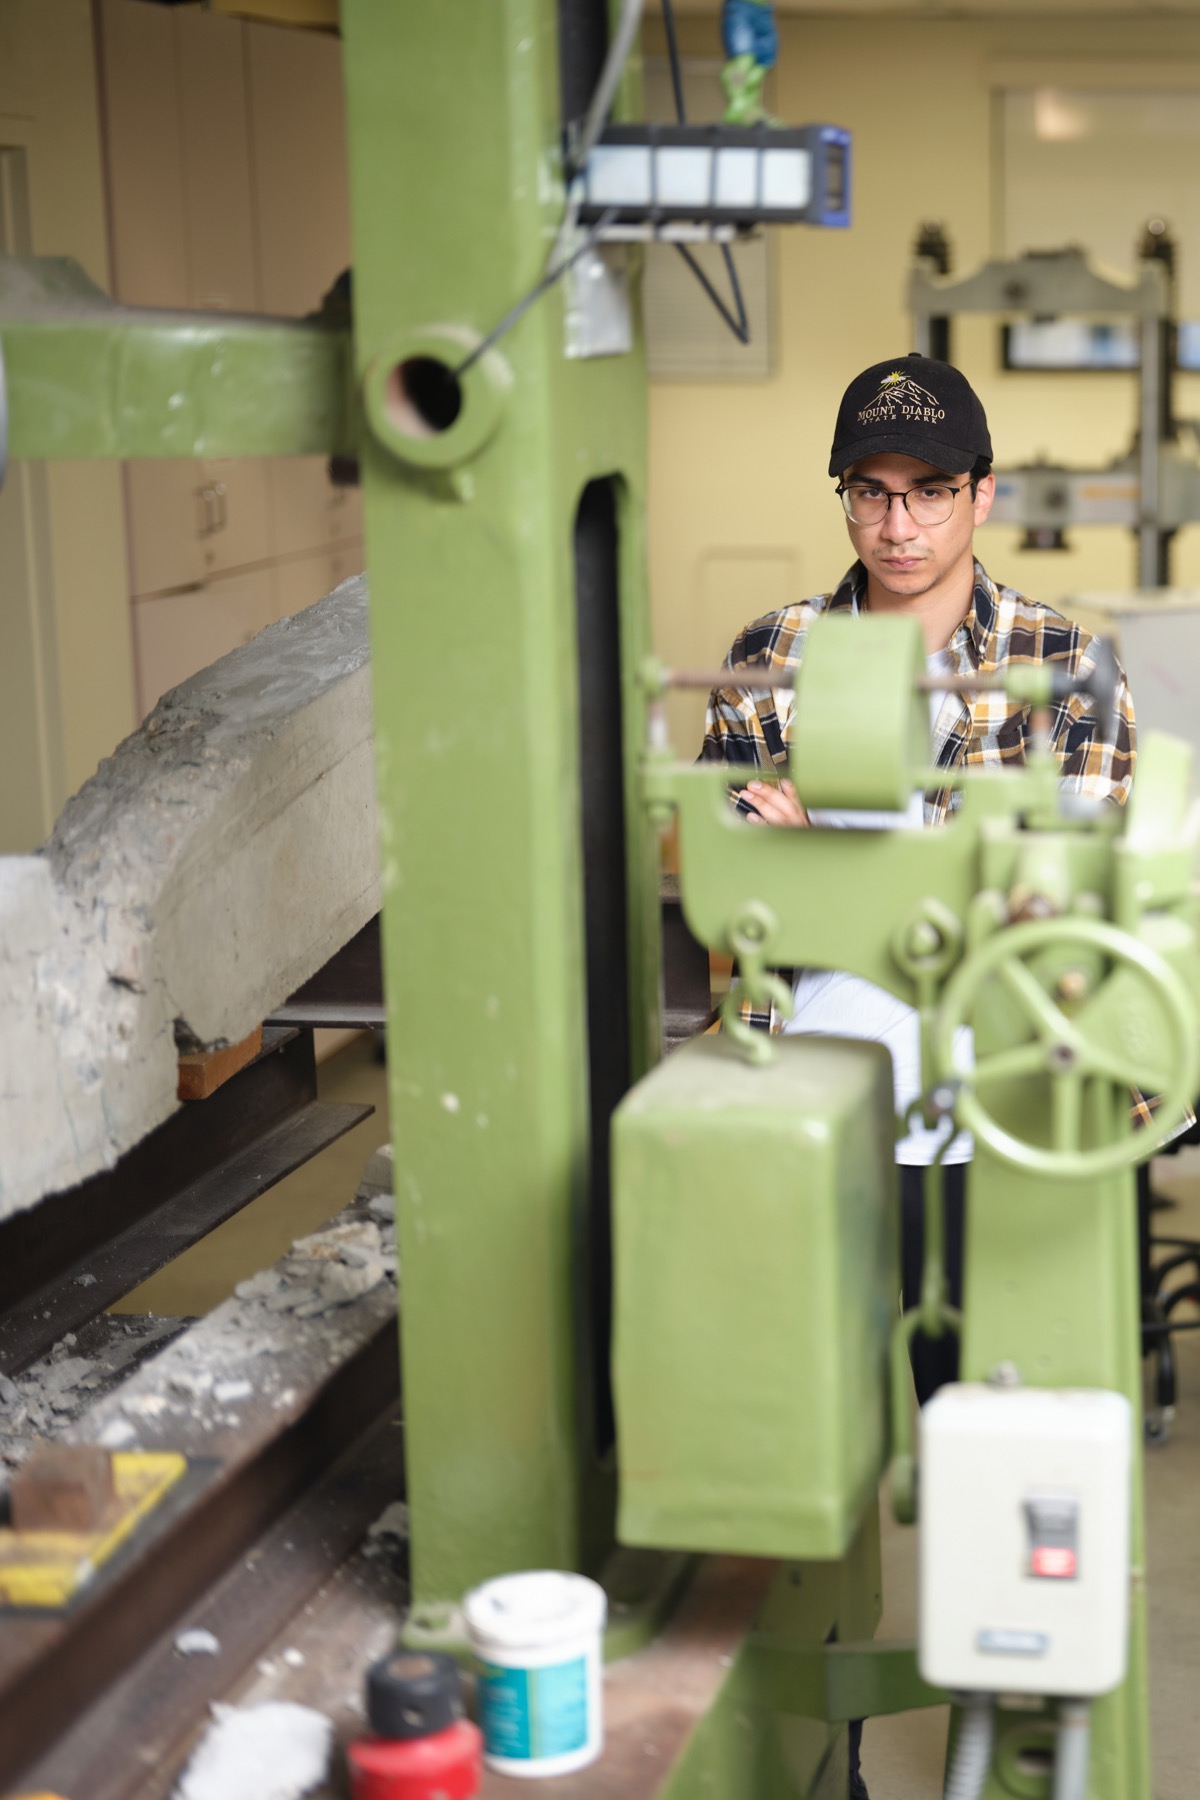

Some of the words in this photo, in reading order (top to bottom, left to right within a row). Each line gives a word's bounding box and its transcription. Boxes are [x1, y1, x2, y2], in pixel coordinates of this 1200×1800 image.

[857, 405, 896, 422] MOUNT
[901, 405, 945, 420] DIABLO
[862, 414, 897, 425] STATE
[906, 414, 937, 424] PARK
